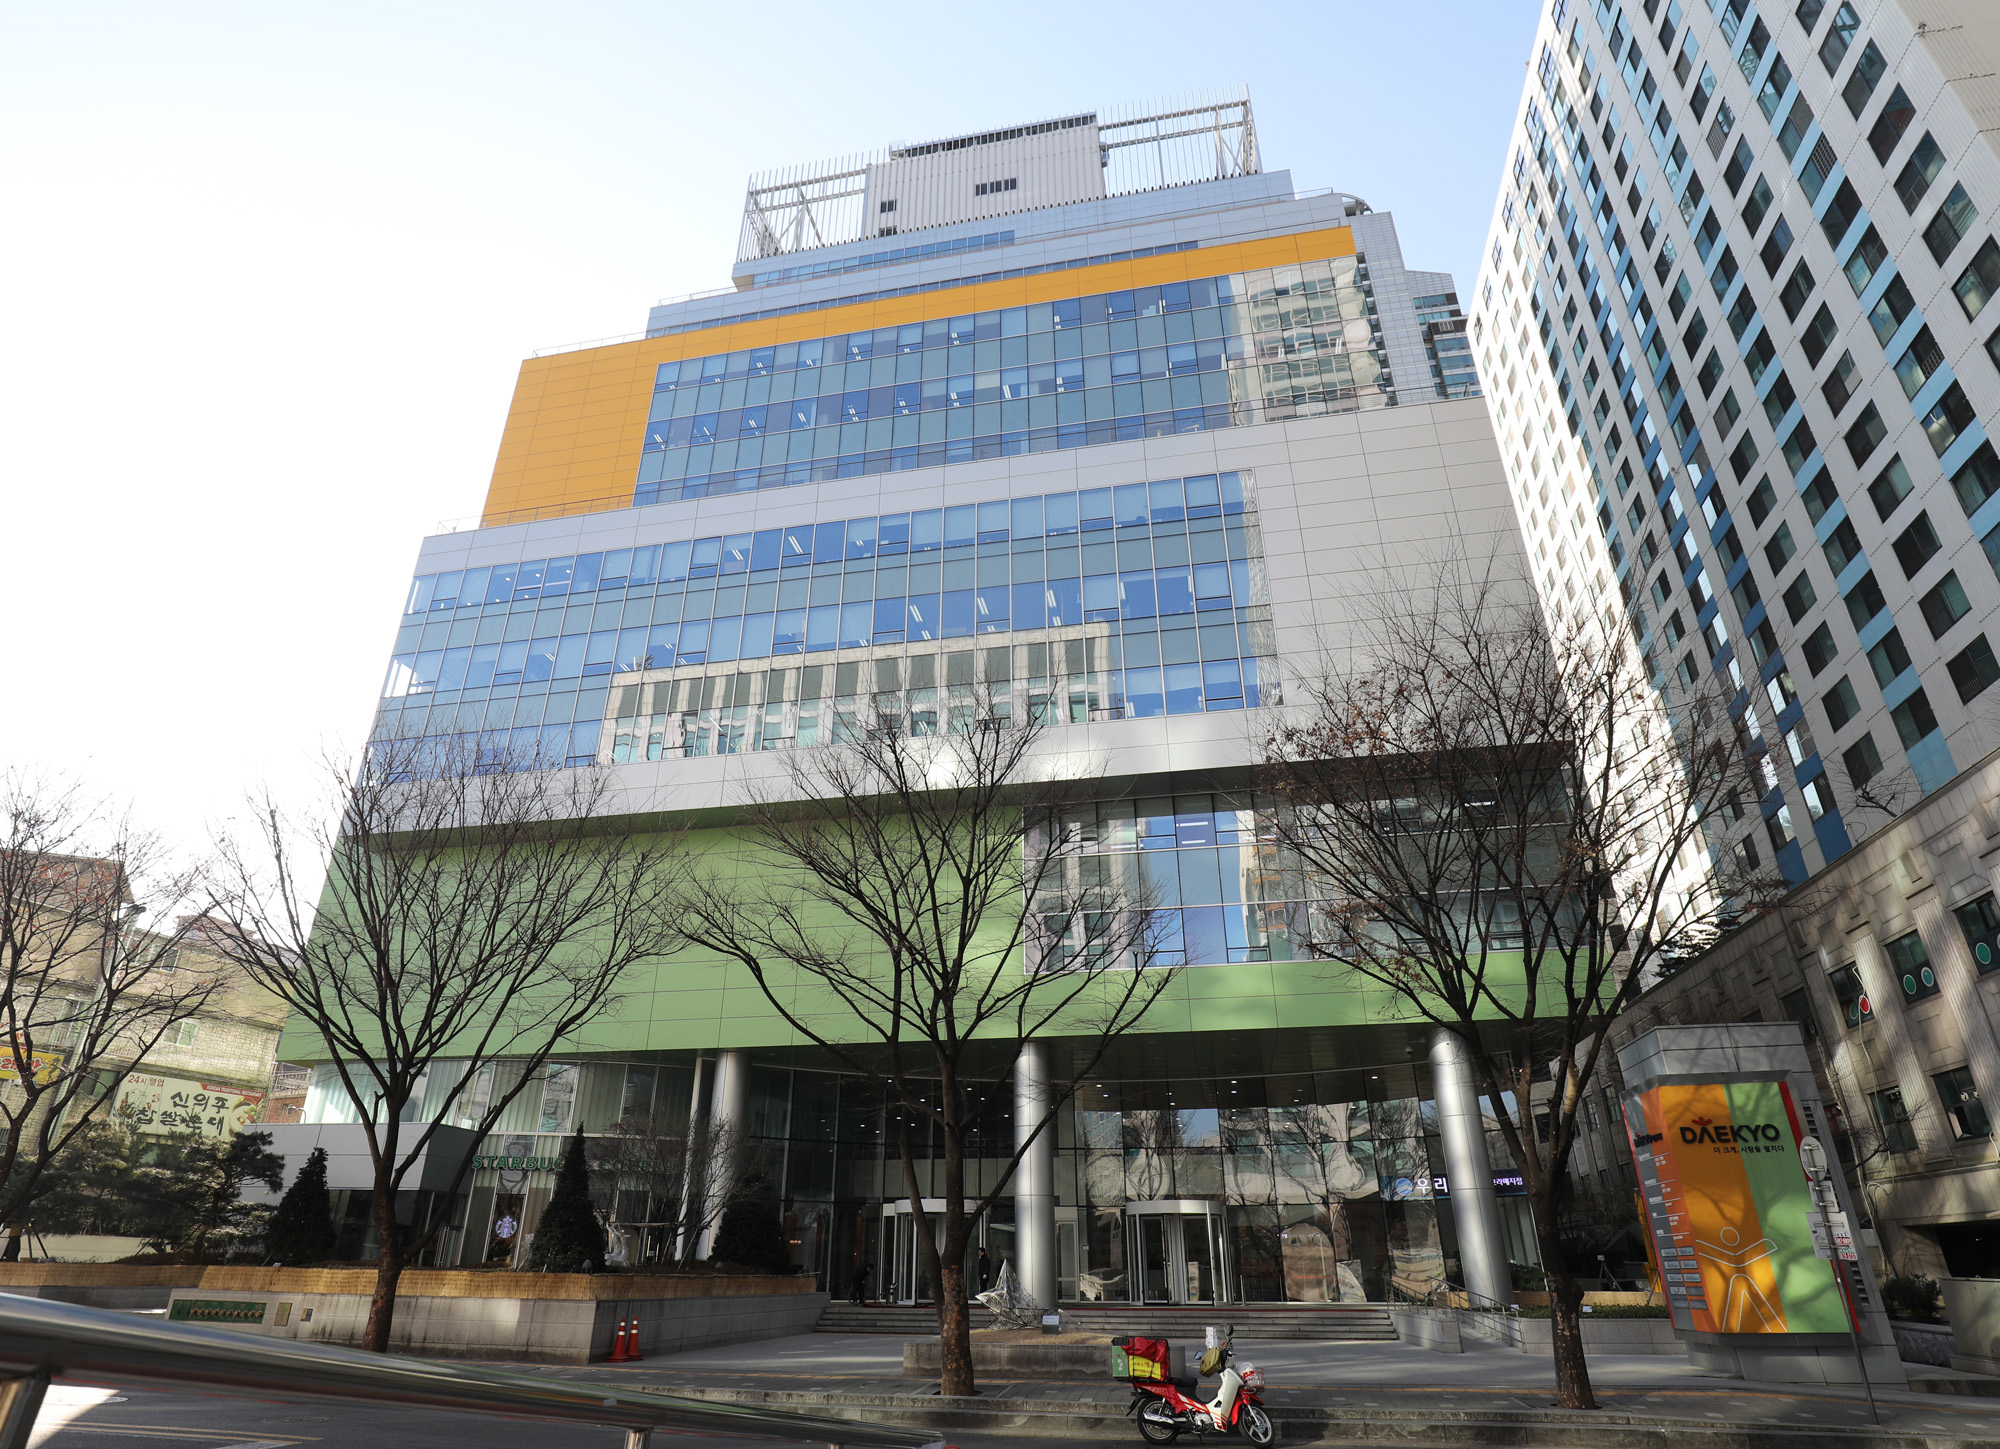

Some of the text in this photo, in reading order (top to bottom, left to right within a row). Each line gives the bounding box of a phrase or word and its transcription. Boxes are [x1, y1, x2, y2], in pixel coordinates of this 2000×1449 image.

[128, 1075, 165, 1088] 24시 영업
[171, 1091, 229, 1114] 신의주
[1679, 1123, 1781, 1145] DAEKYO
